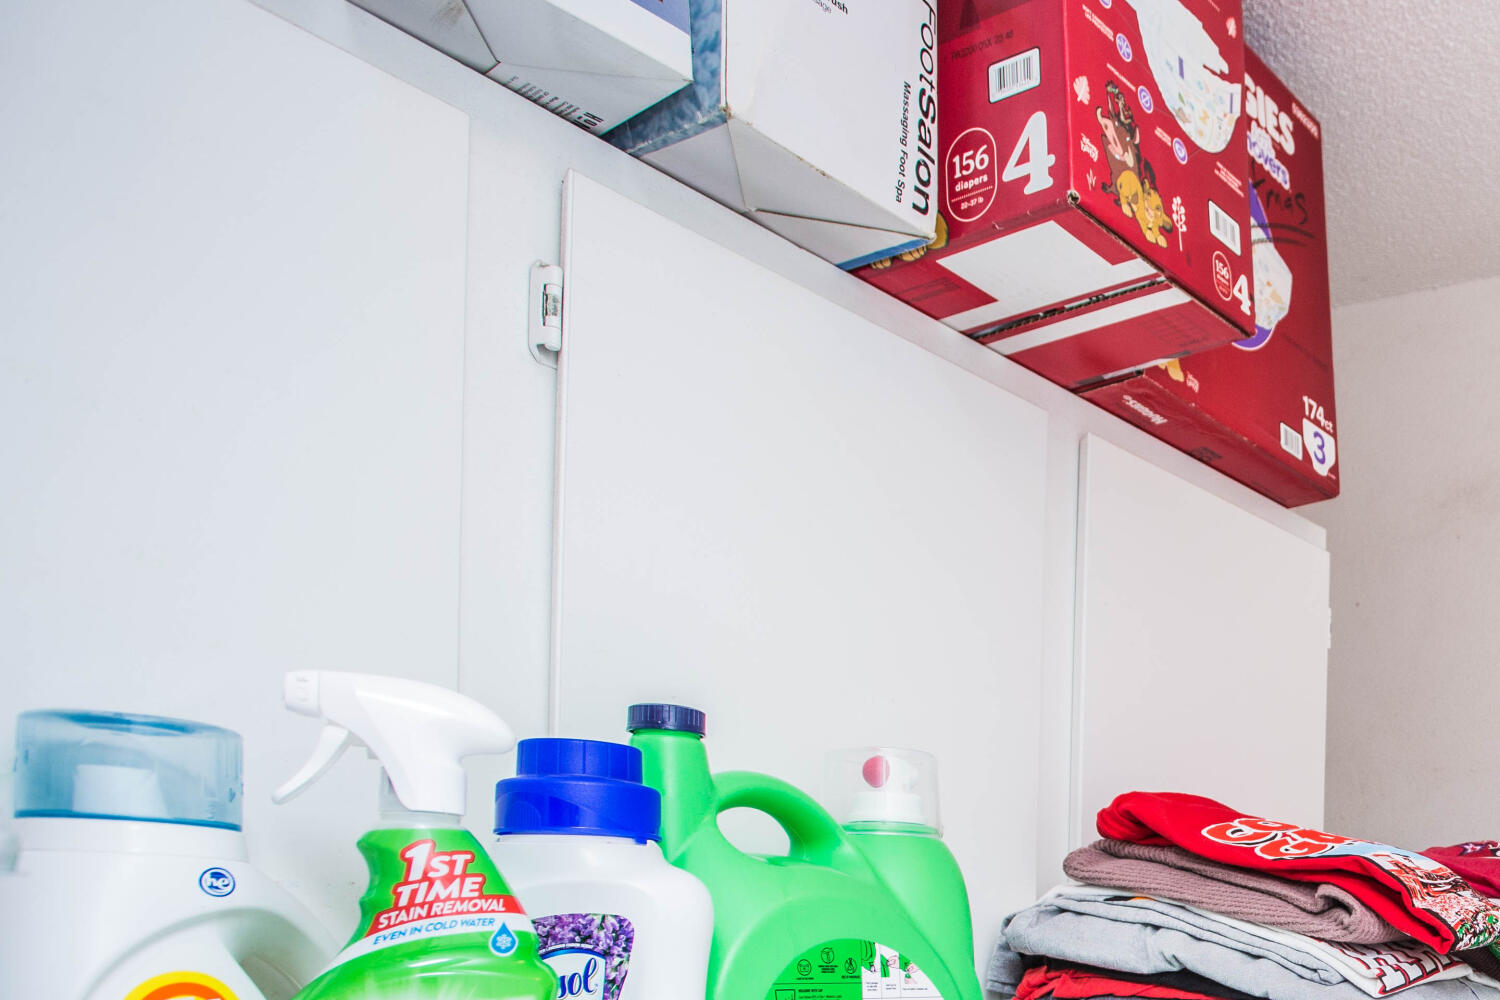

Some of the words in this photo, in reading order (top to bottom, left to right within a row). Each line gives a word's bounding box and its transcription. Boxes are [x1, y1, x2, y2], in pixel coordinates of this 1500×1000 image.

[900, 81, 912, 147] Massaging
[912, 0, 936, 215] FootSalon
[1244, 72, 1295, 155] GIES
[900, 150, 909, 177] Foot
[952, 145, 989, 178] 156
[1002, 111, 1055, 195] 4
[896, 180, 906, 203] Spa
[956, 174, 988, 192] diapers
[1215, 259, 1230, 278] 156
[1233, 274, 1250, 315] 4
[1313, 431, 1326, 465] 3
[405, 842, 472, 882] 1ST
[397, 876, 482, 907] TIME
[378, 906, 428, 929] STAIN
[430, 898, 506, 920] REMOVAL
[373, 928, 406, 945] EVEN
[409, 926, 423, 936] IN
[426, 919, 458, 932] COLD
[460, 918, 496, 927] WATER
[558, 957, 598, 999] sol
